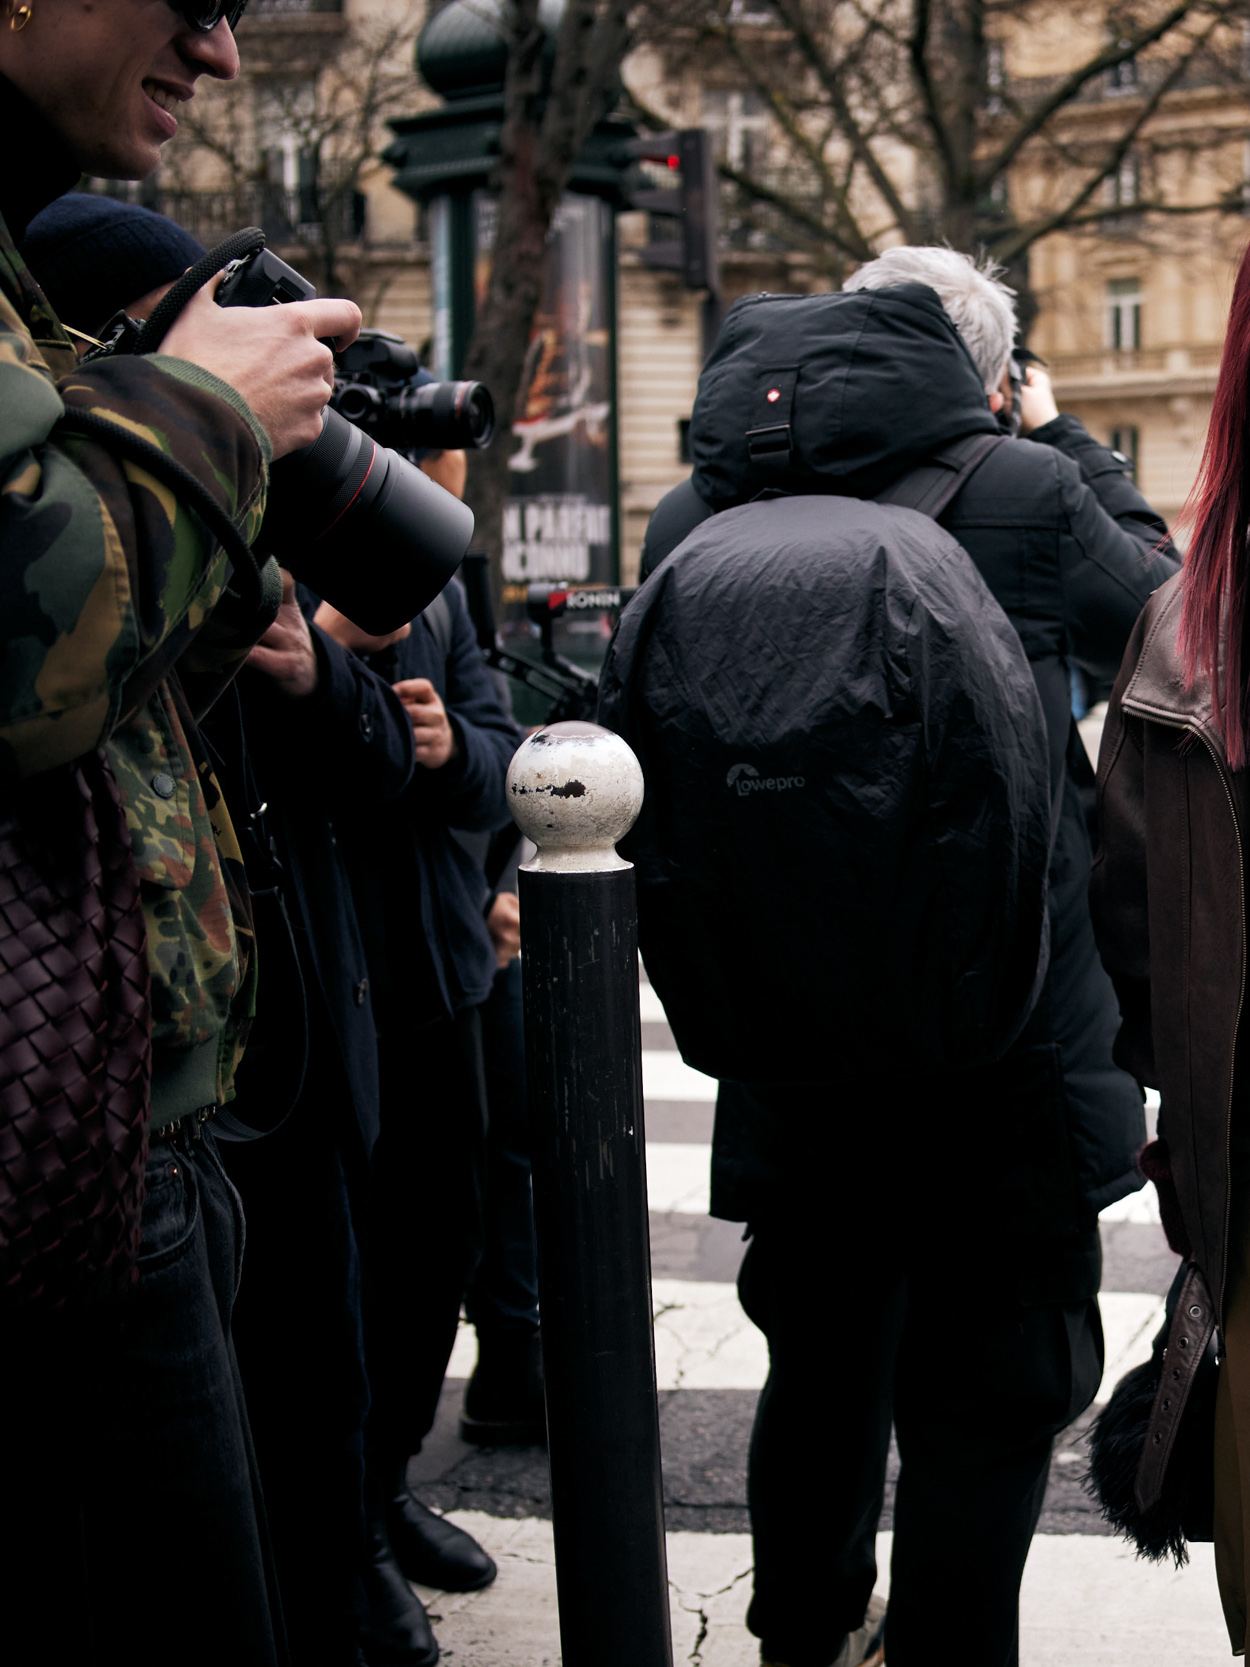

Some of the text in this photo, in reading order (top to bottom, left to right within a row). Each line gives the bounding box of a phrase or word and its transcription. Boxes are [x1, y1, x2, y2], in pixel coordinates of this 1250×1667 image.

[501, 504, 521, 541] N
[566, 592, 620, 609] RONIN
[735, 775, 806, 797] Lowepro
